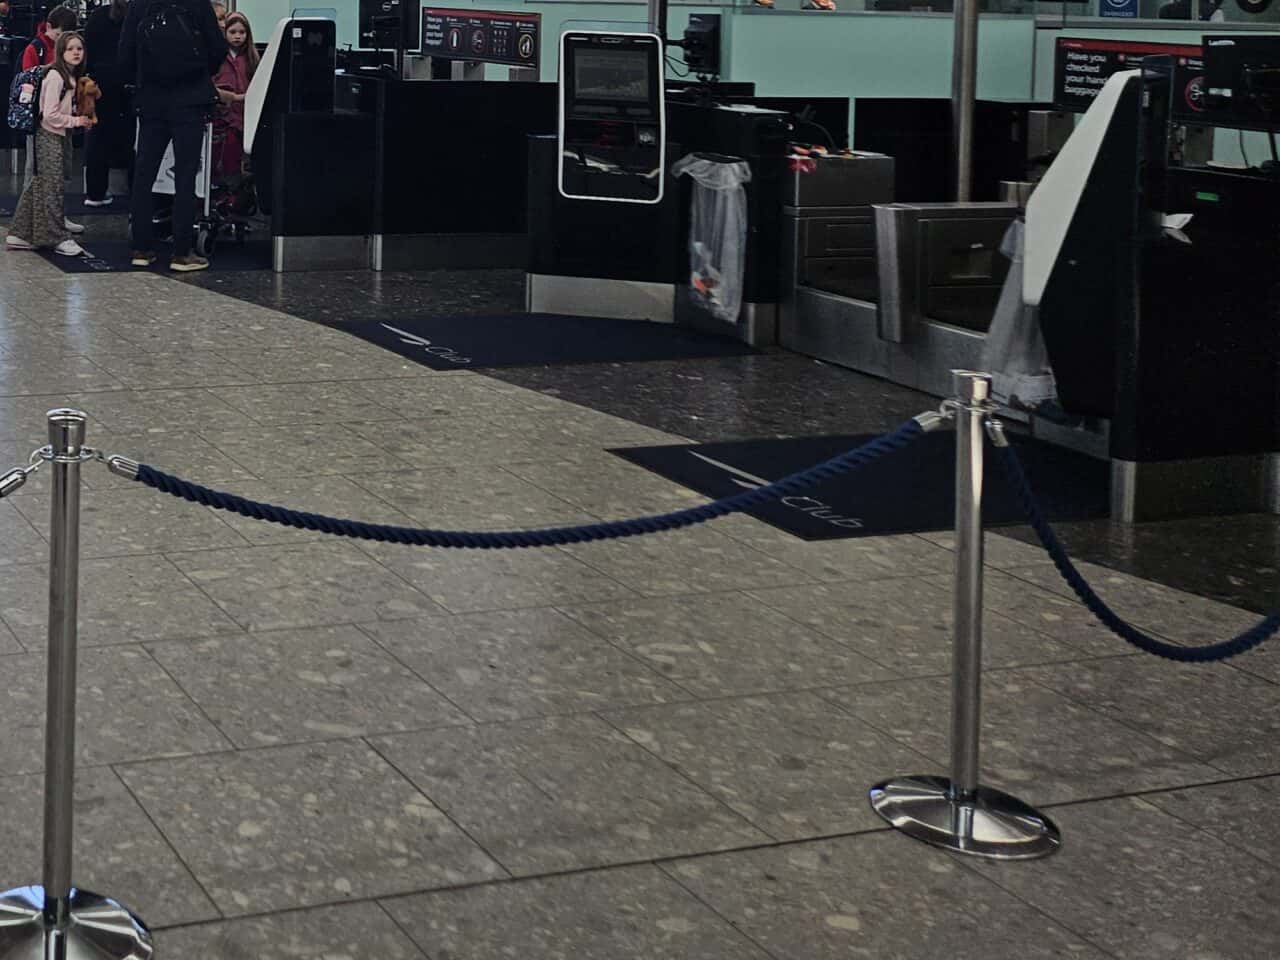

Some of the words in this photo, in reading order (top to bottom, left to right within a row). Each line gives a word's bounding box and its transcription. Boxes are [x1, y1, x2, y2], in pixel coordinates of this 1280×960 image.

[1067, 51, 1089, 61] Have
[1089, 54, 1107, 64] you
[1065, 64, 1100, 73] checked
[781, 495, 864, 528] Club
